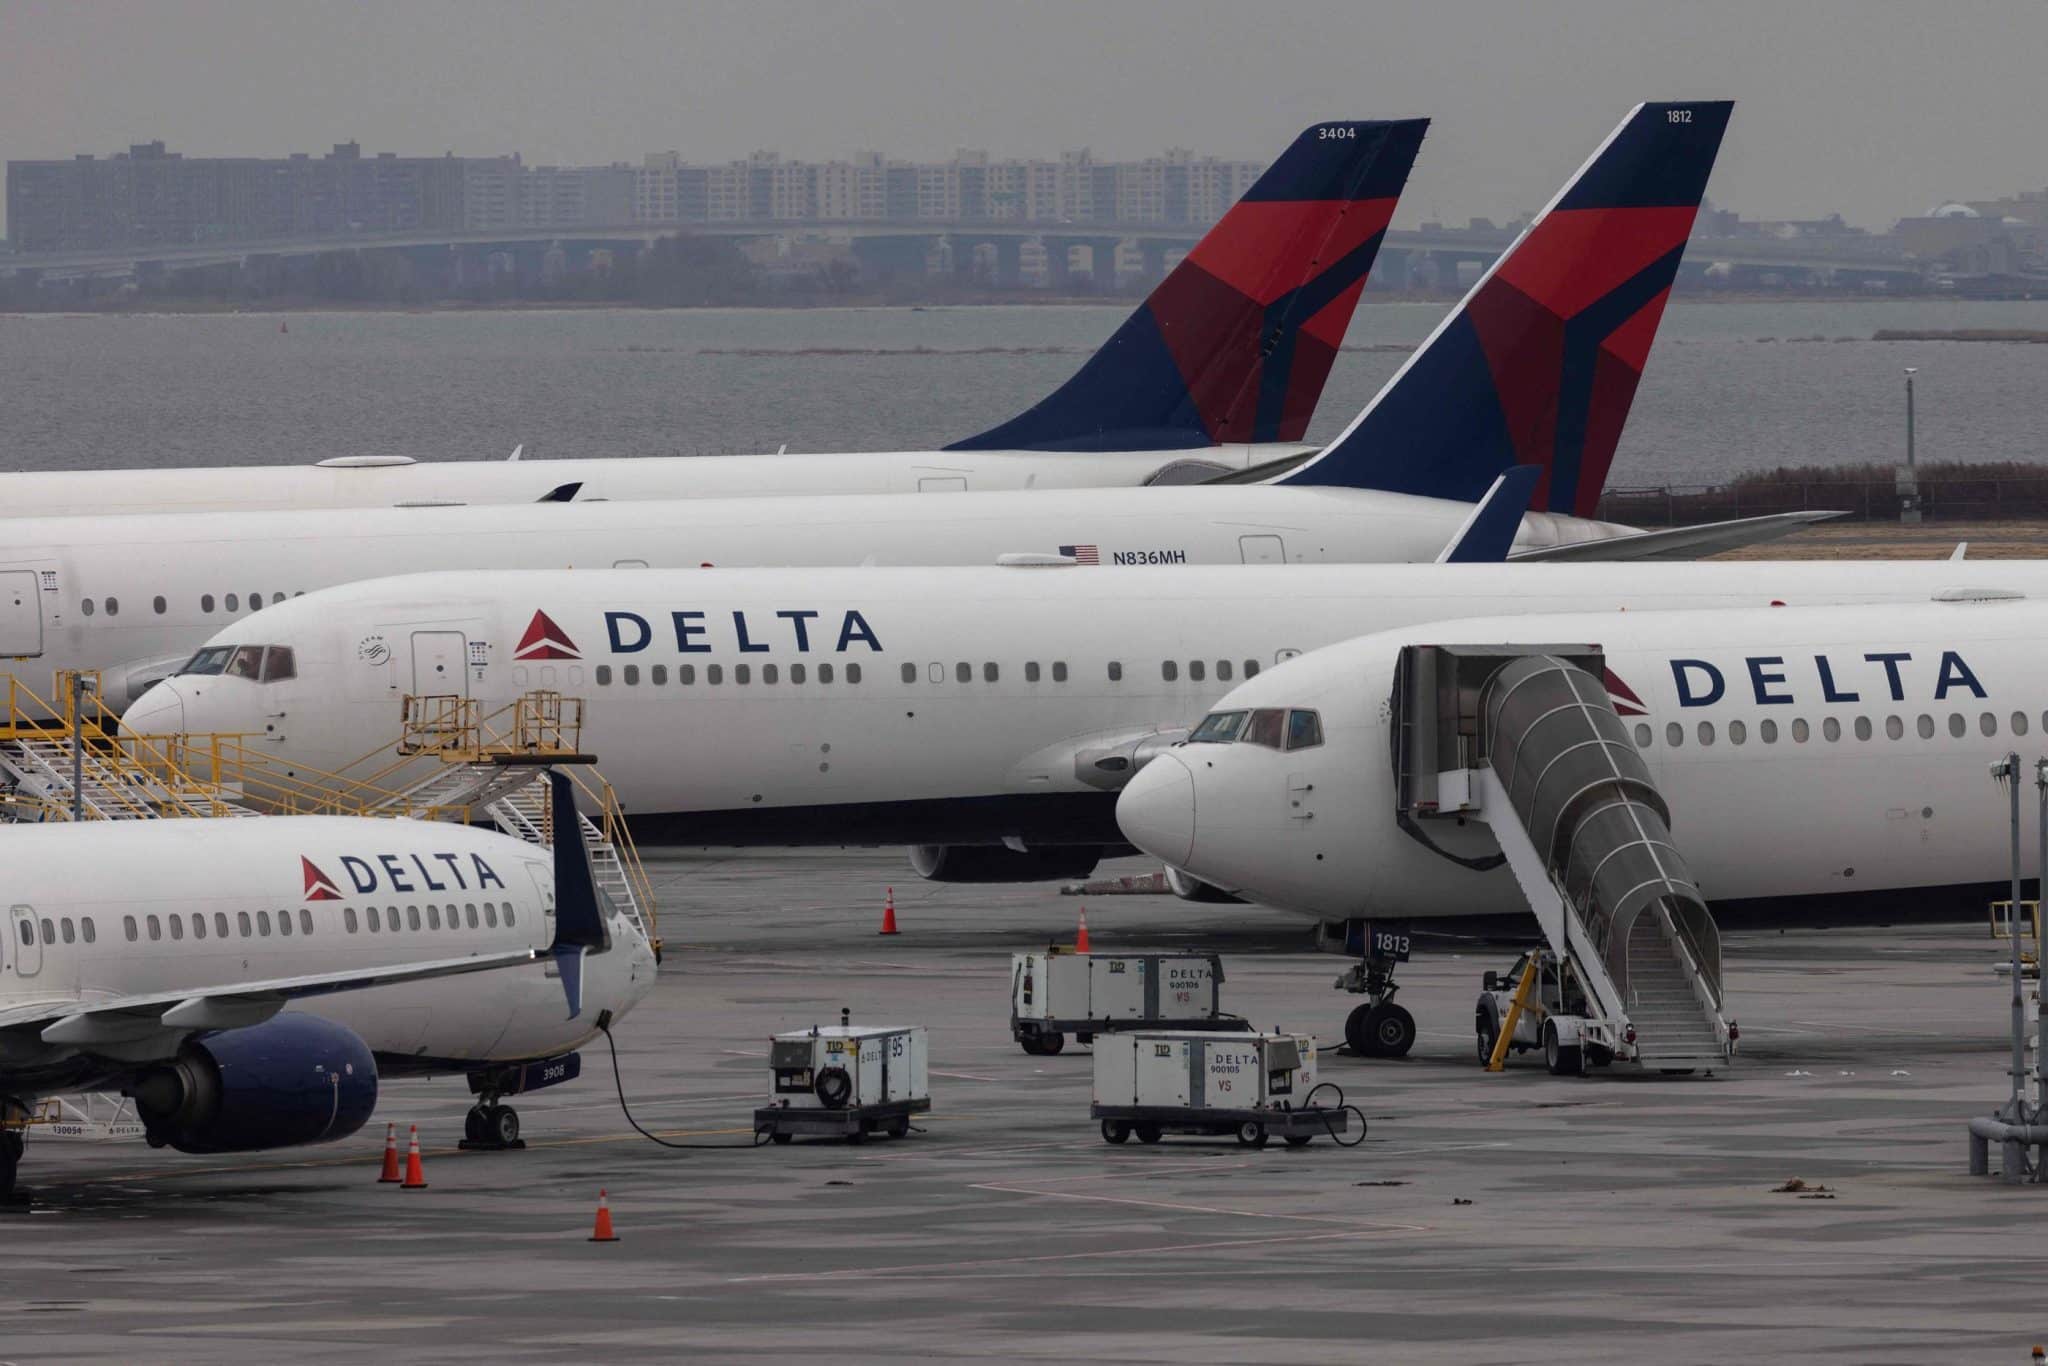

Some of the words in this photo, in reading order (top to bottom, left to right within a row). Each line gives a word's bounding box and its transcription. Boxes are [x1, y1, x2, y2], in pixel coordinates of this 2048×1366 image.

[1666, 110, 1693, 123] 1812
[1319, 127, 1357, 140] 3404
[1113, 550, 1186, 565] N836MH
[604, 610, 884, 653] DELTA
[1669, 651, 1988, 707] DELTA
[339, 853, 506, 894] DELTA
[1376, 932, 1410, 953] 1813
[1170, 969, 1212, 978] DELTA
[1215, 1054, 1258, 1065] DELTA
[543, 1064, 565, 1081] 3908
[1218, 1079, 1232, 1092] VS
